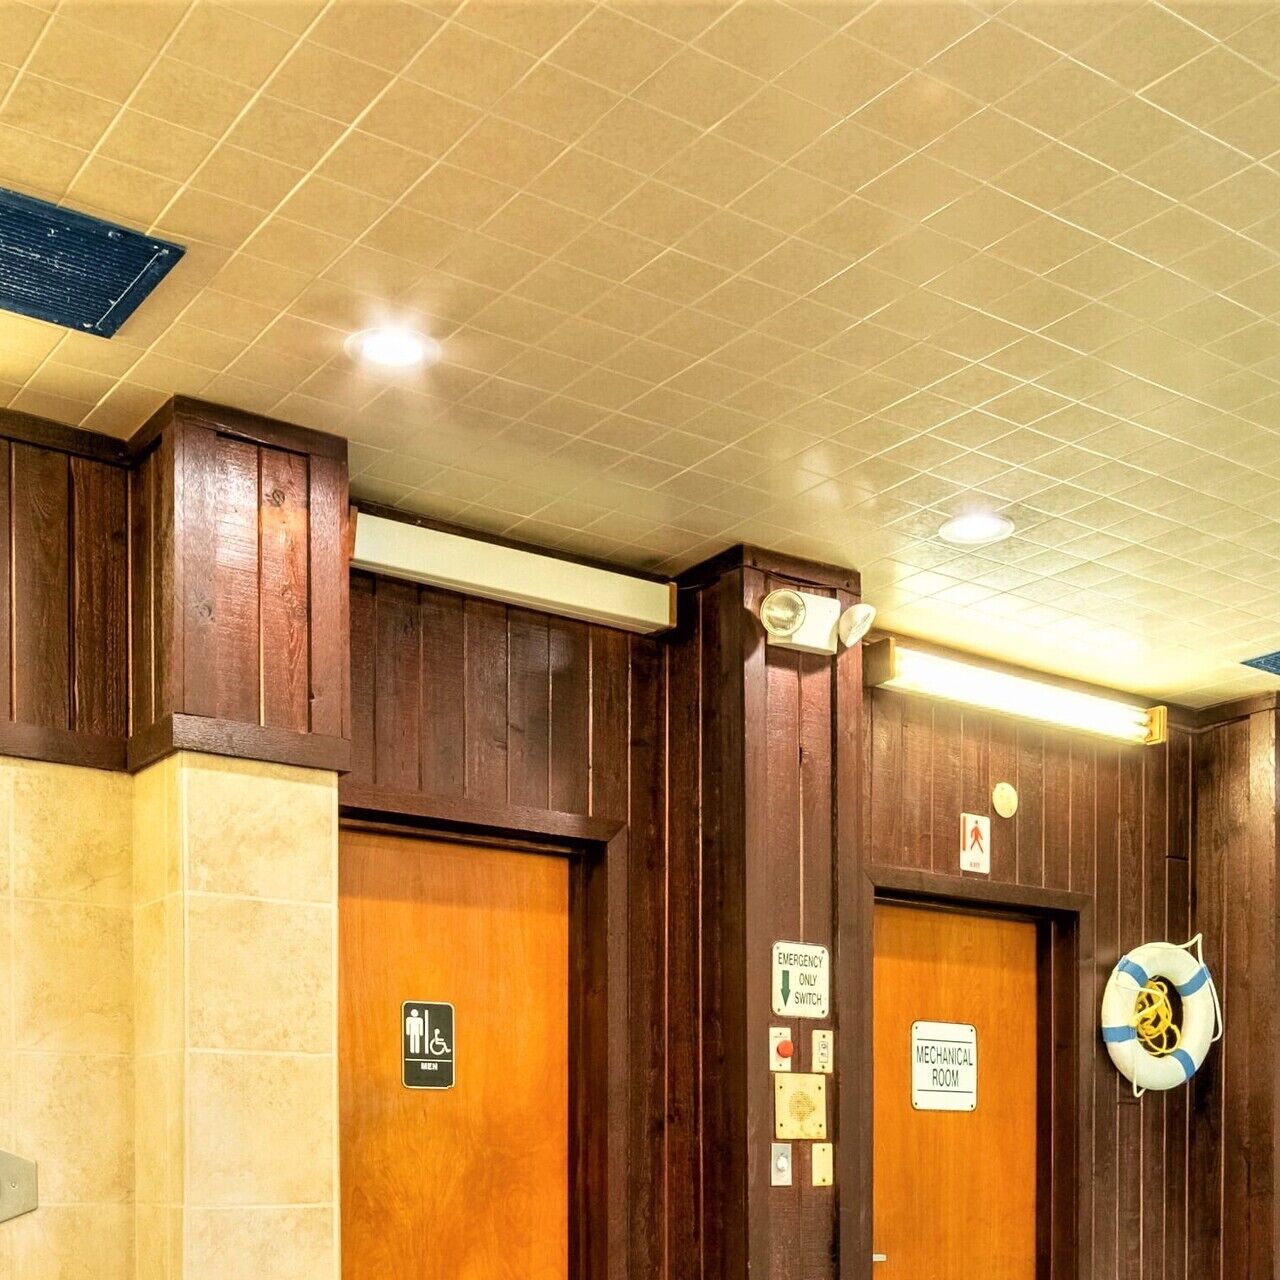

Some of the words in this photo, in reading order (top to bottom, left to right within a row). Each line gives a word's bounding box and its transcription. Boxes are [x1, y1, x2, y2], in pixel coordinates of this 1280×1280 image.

[778, 952, 823, 968] EMERGENCY
[799, 973, 817, 986] ONLY
[794, 991, 822, 1005] SWITCH
[916, 1046, 973, 1066] MECHANICAL
[420, 1062, 439, 1071] MEN
[931, 1068, 959, 1087] ROOM
